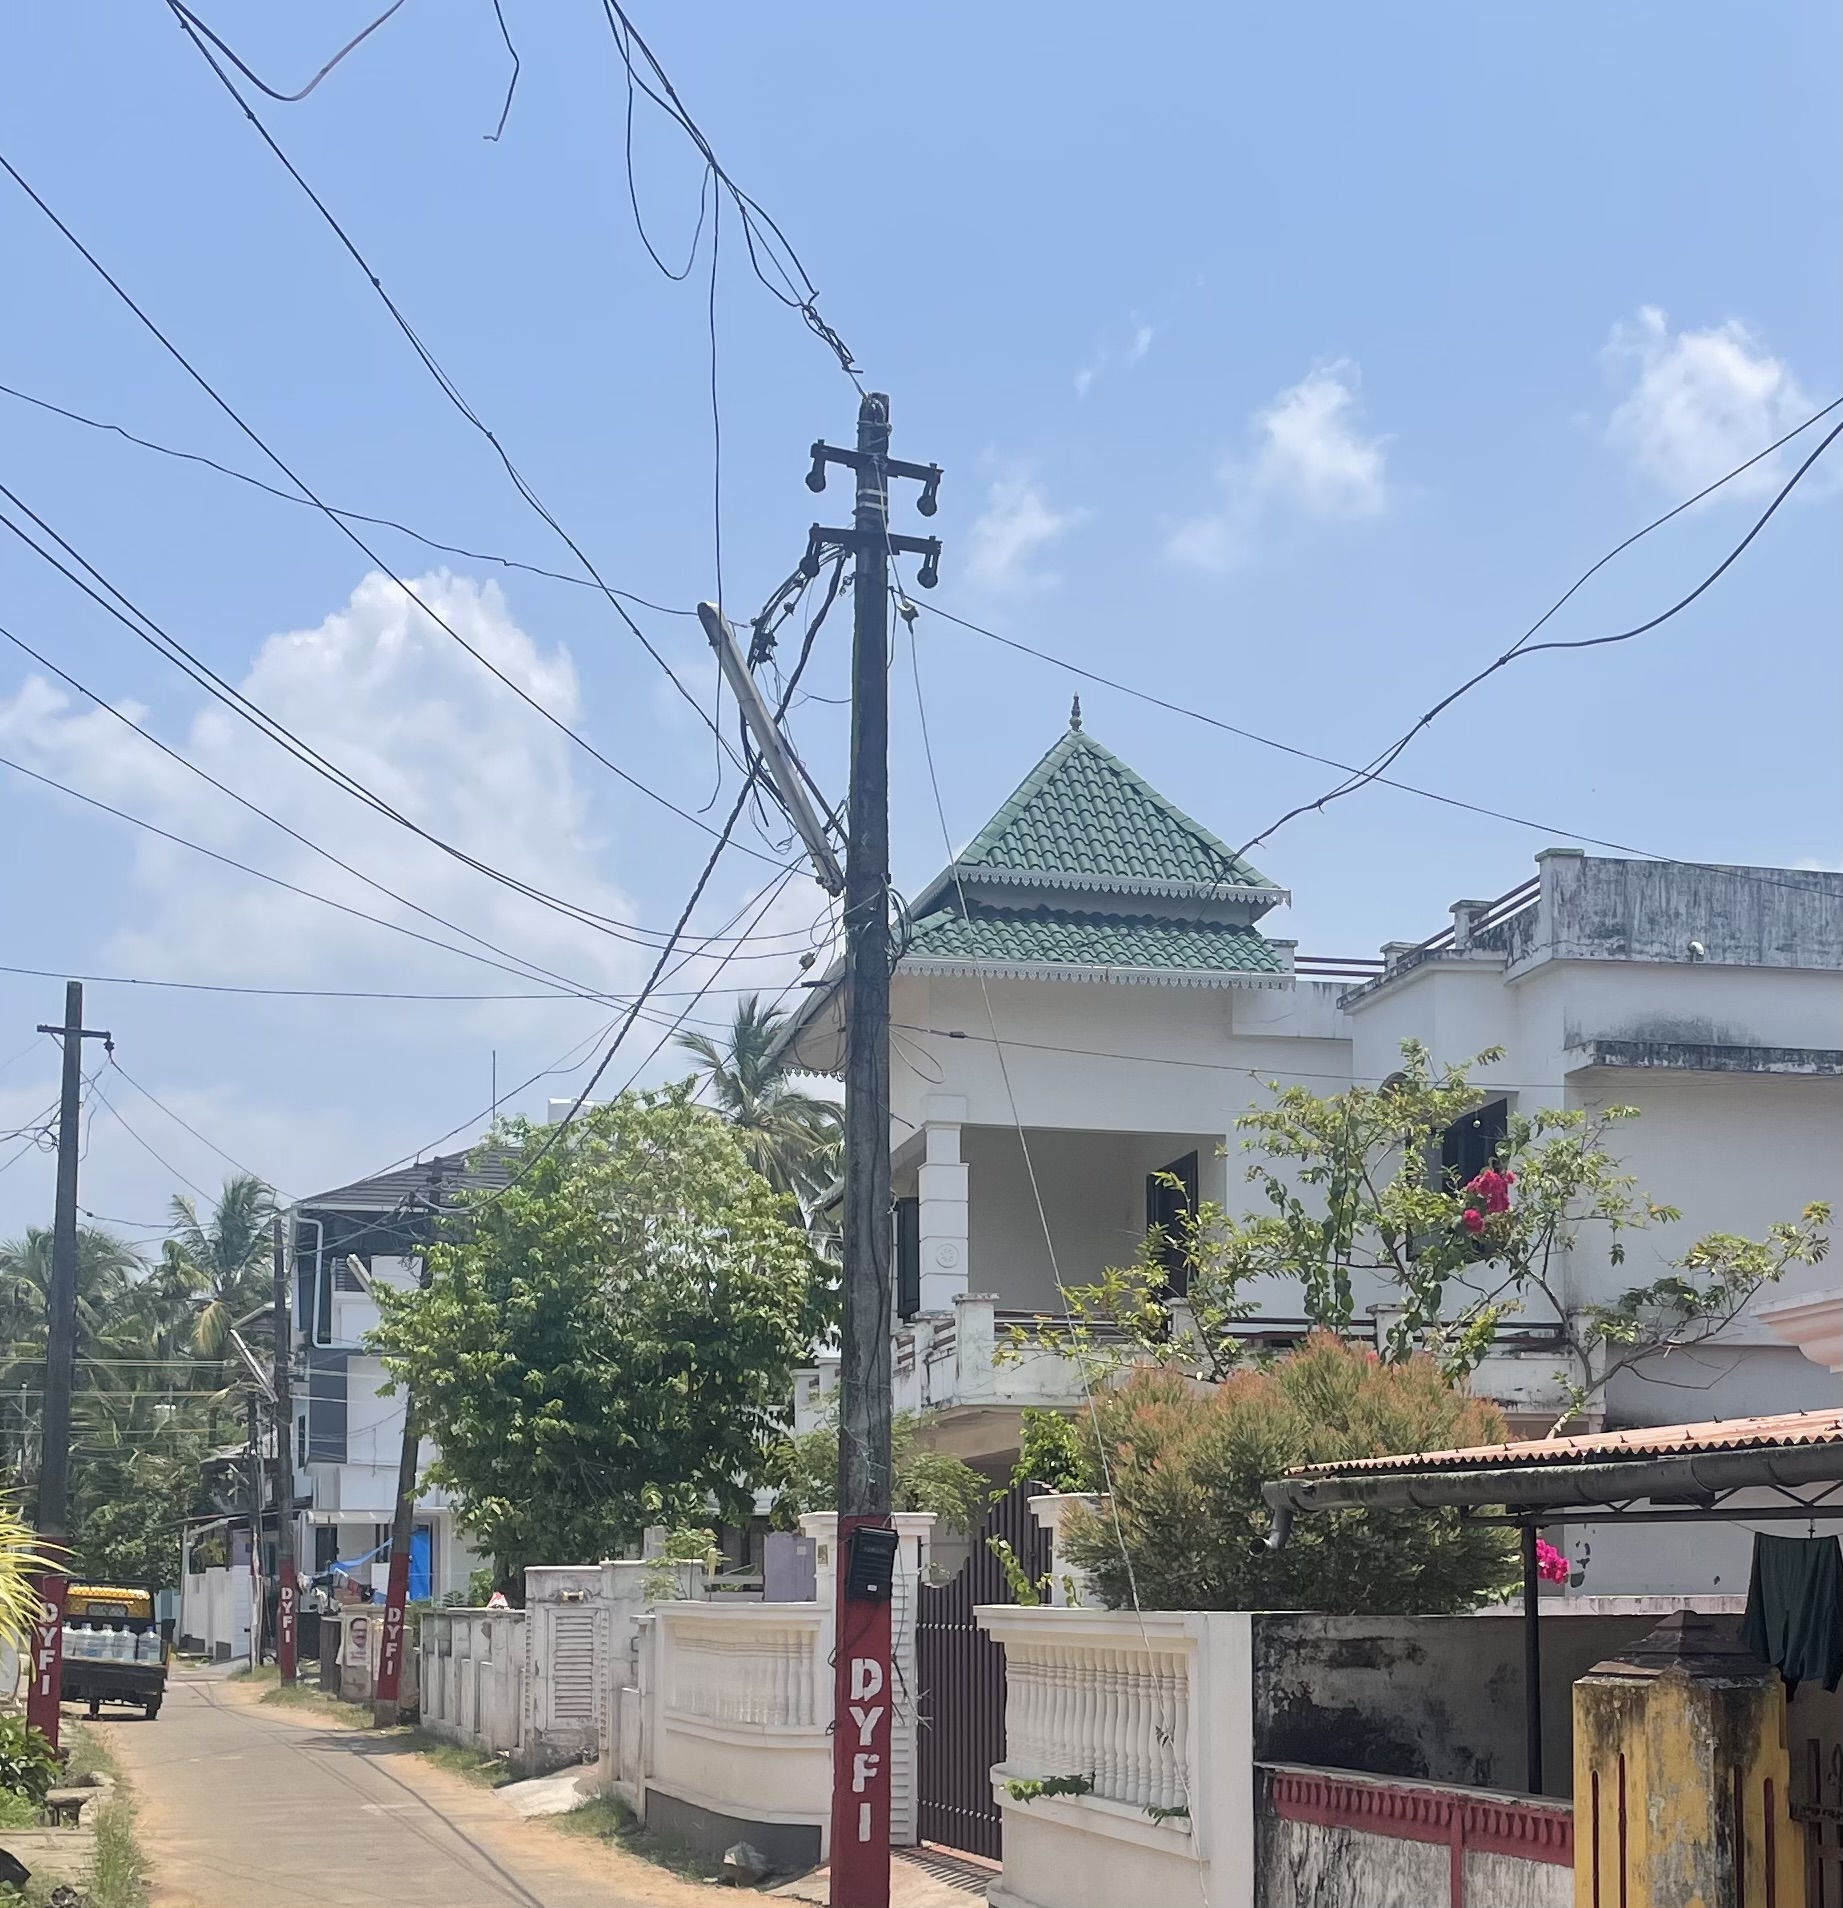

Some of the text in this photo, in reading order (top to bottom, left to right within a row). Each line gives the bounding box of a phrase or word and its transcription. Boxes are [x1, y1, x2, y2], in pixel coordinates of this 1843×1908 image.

[281, 1587, 293, 1643] DYFI
[386, 1607, 402, 1675] DYFI
[849, 1658, 884, 1842] DYFI
